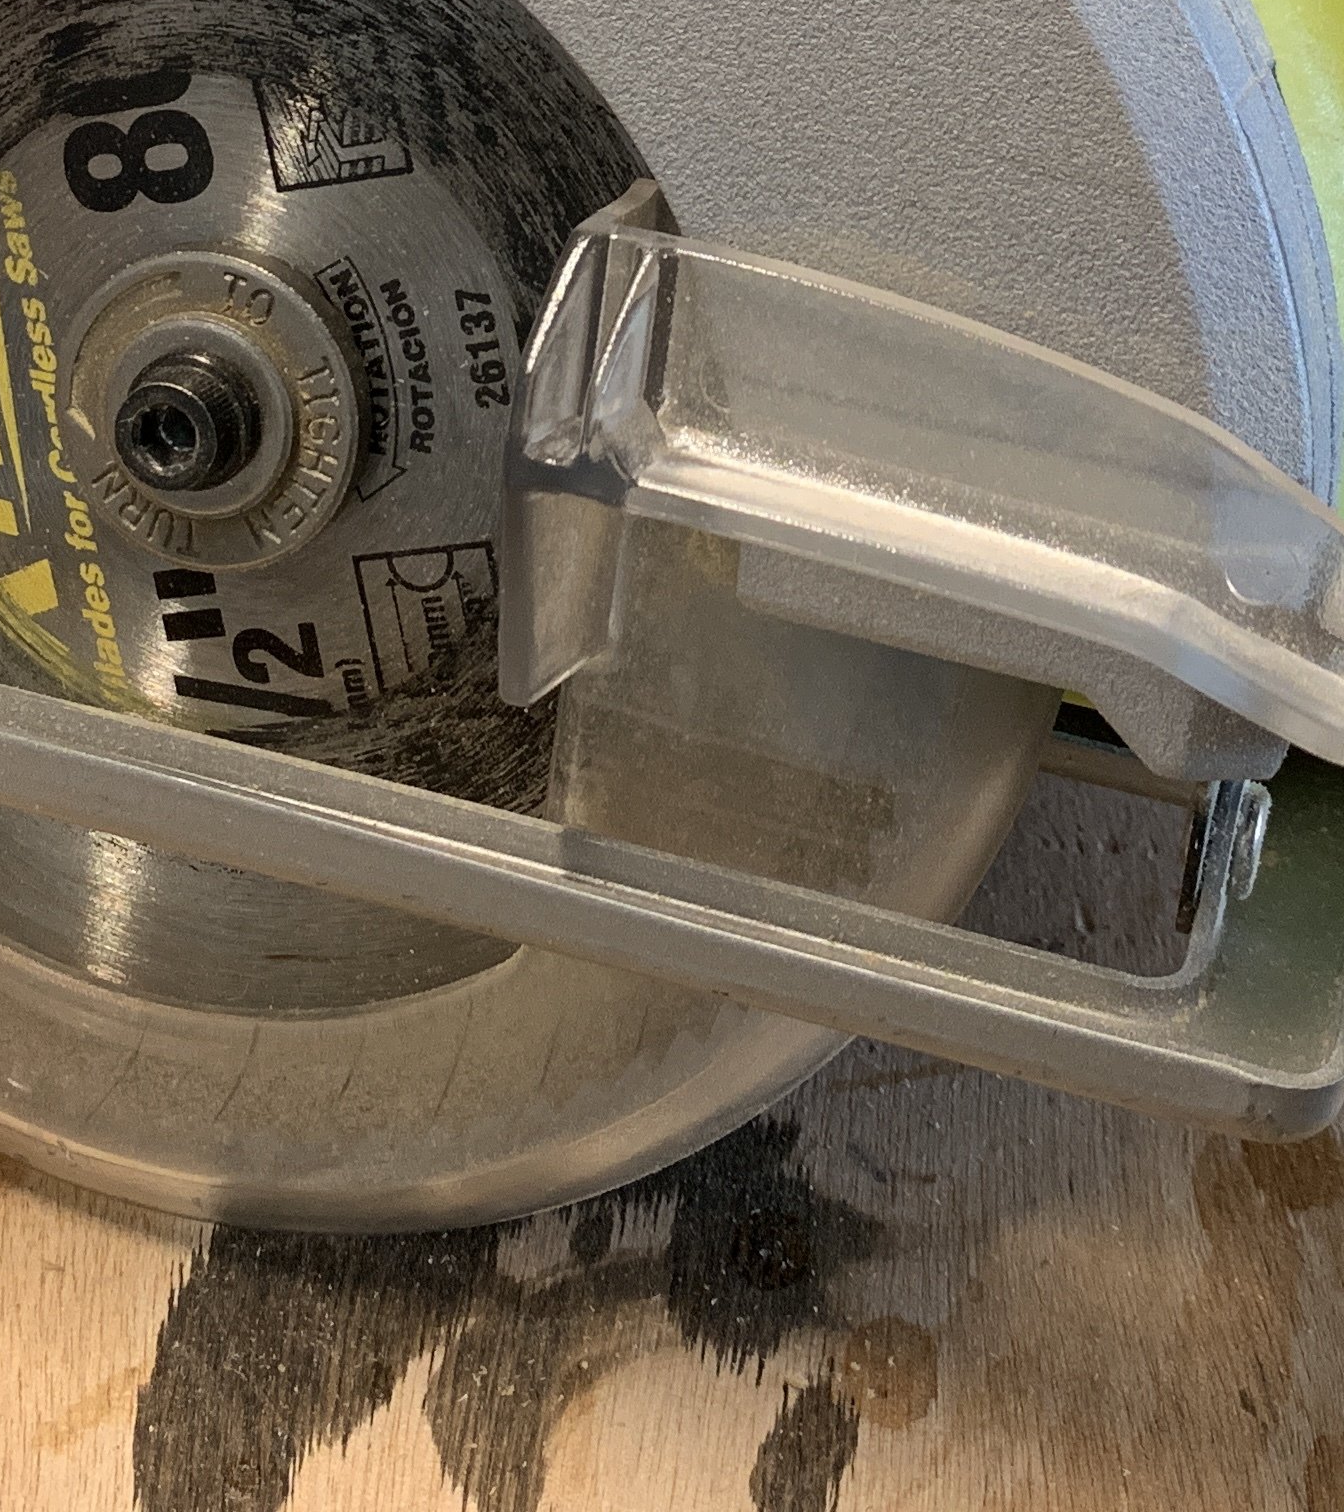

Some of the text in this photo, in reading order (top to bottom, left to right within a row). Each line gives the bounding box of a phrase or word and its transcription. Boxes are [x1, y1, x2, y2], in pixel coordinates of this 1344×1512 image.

[92, 271, 340, 558] TURN TO TIGHTEN
[329, 267, 391, 455] ROTATION
[380, 278, 436, 454] ROTACIÓN
[455, 289, 510, 409] 26137
[64, 490, 99, 555] for
